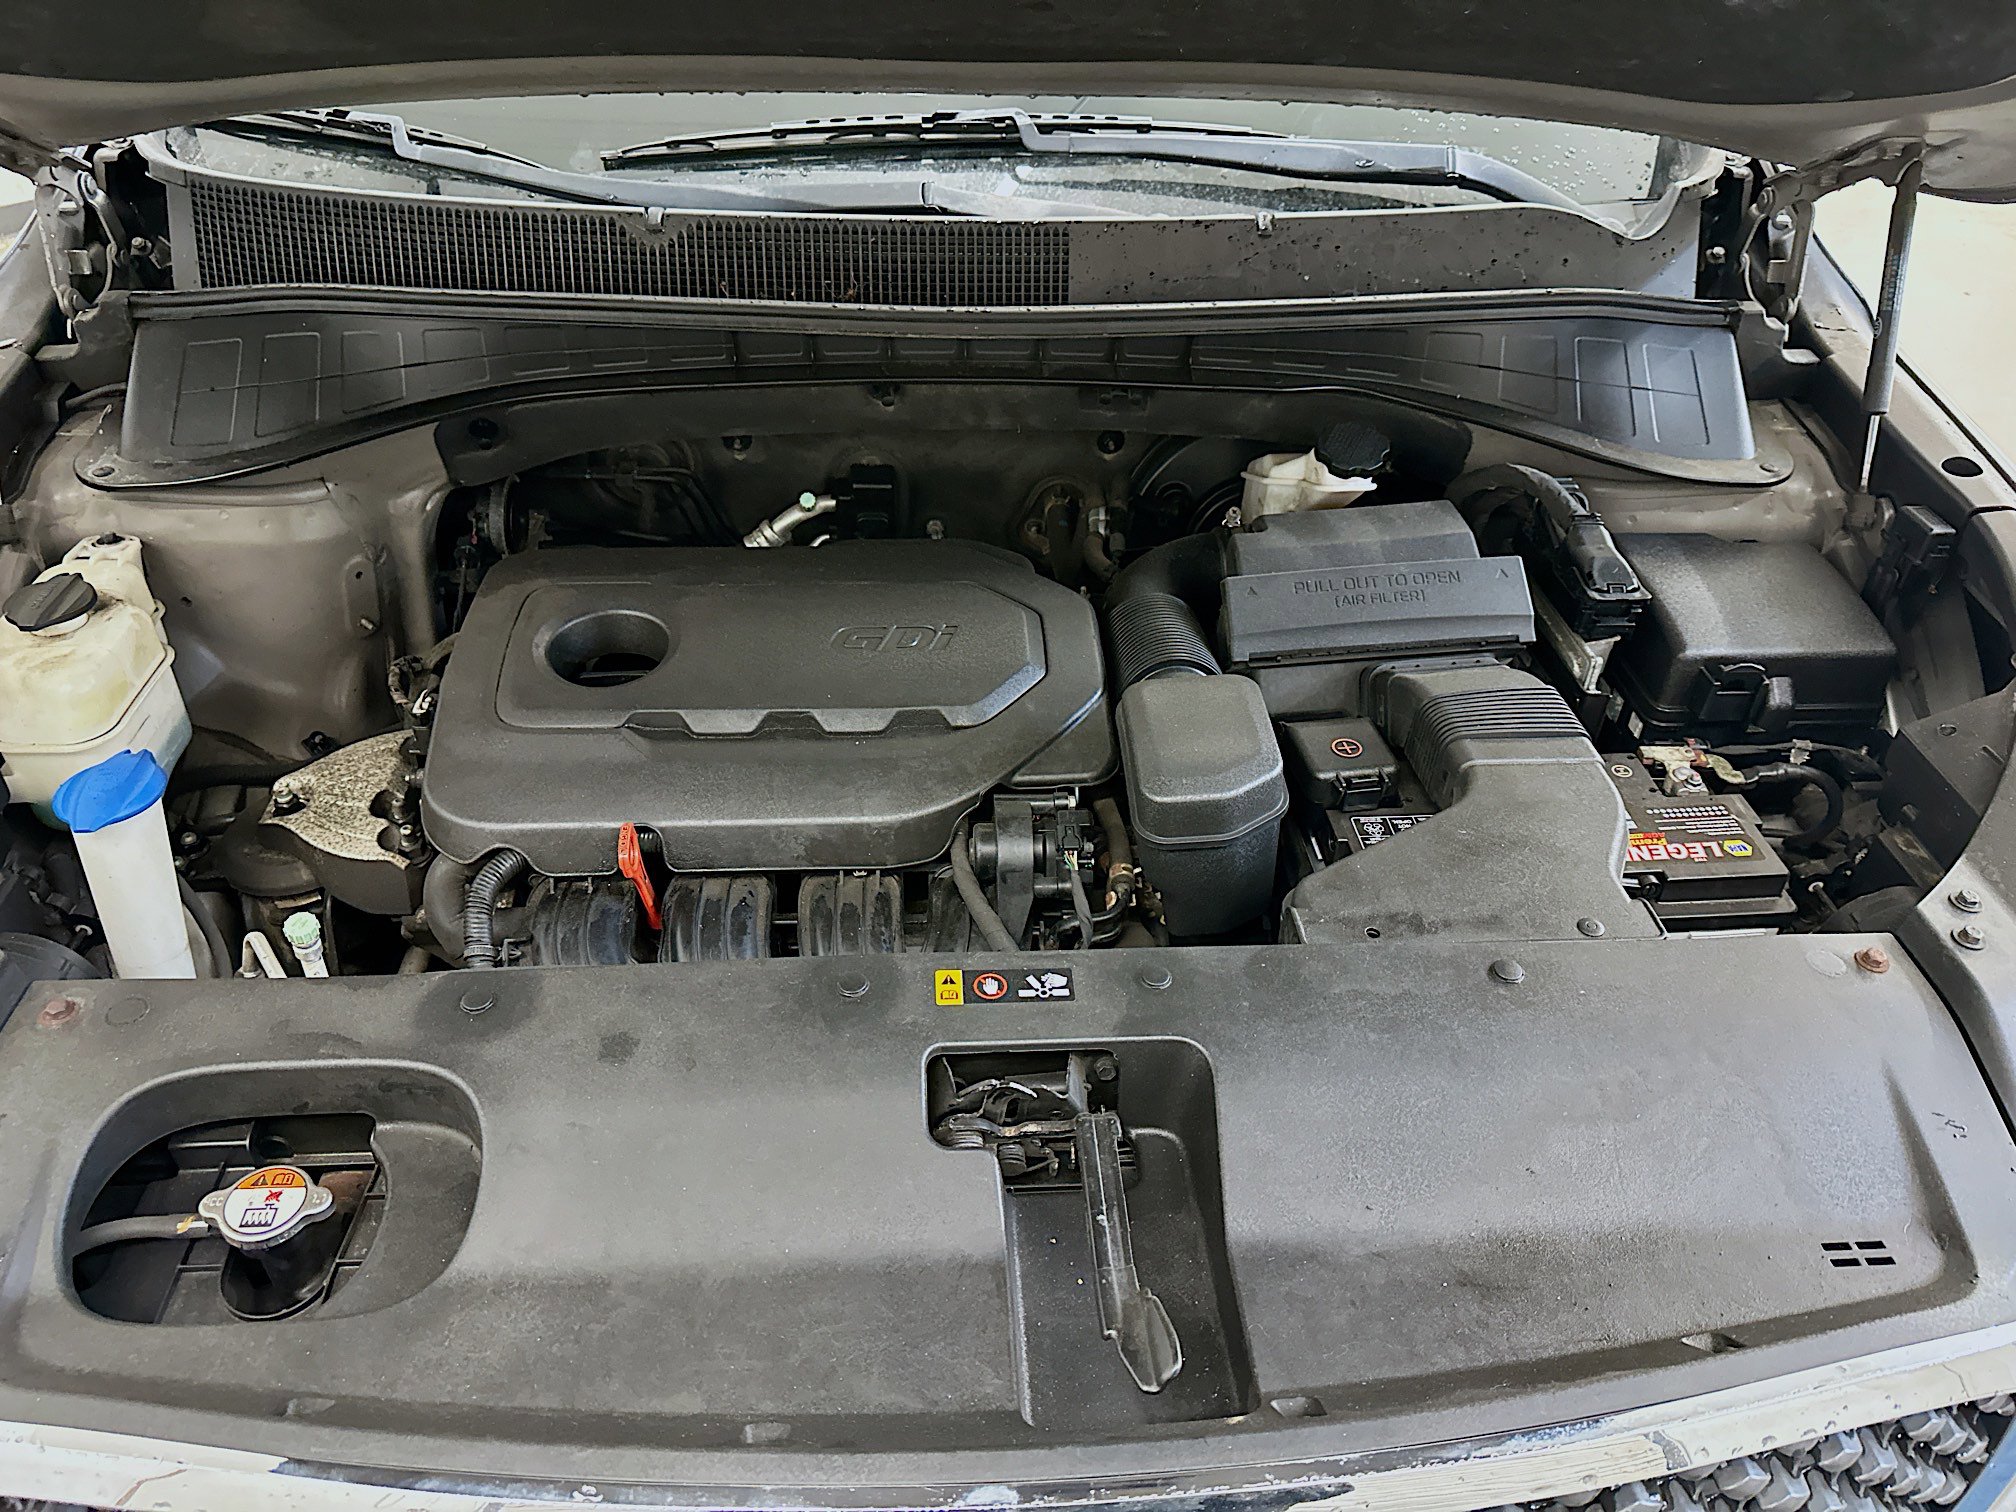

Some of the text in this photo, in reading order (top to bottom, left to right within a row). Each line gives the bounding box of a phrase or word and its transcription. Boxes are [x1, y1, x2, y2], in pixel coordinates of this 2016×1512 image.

[1294, 570, 1461, 594] PULL OUT TO OPEN
[830, 625, 958, 652] GDi
